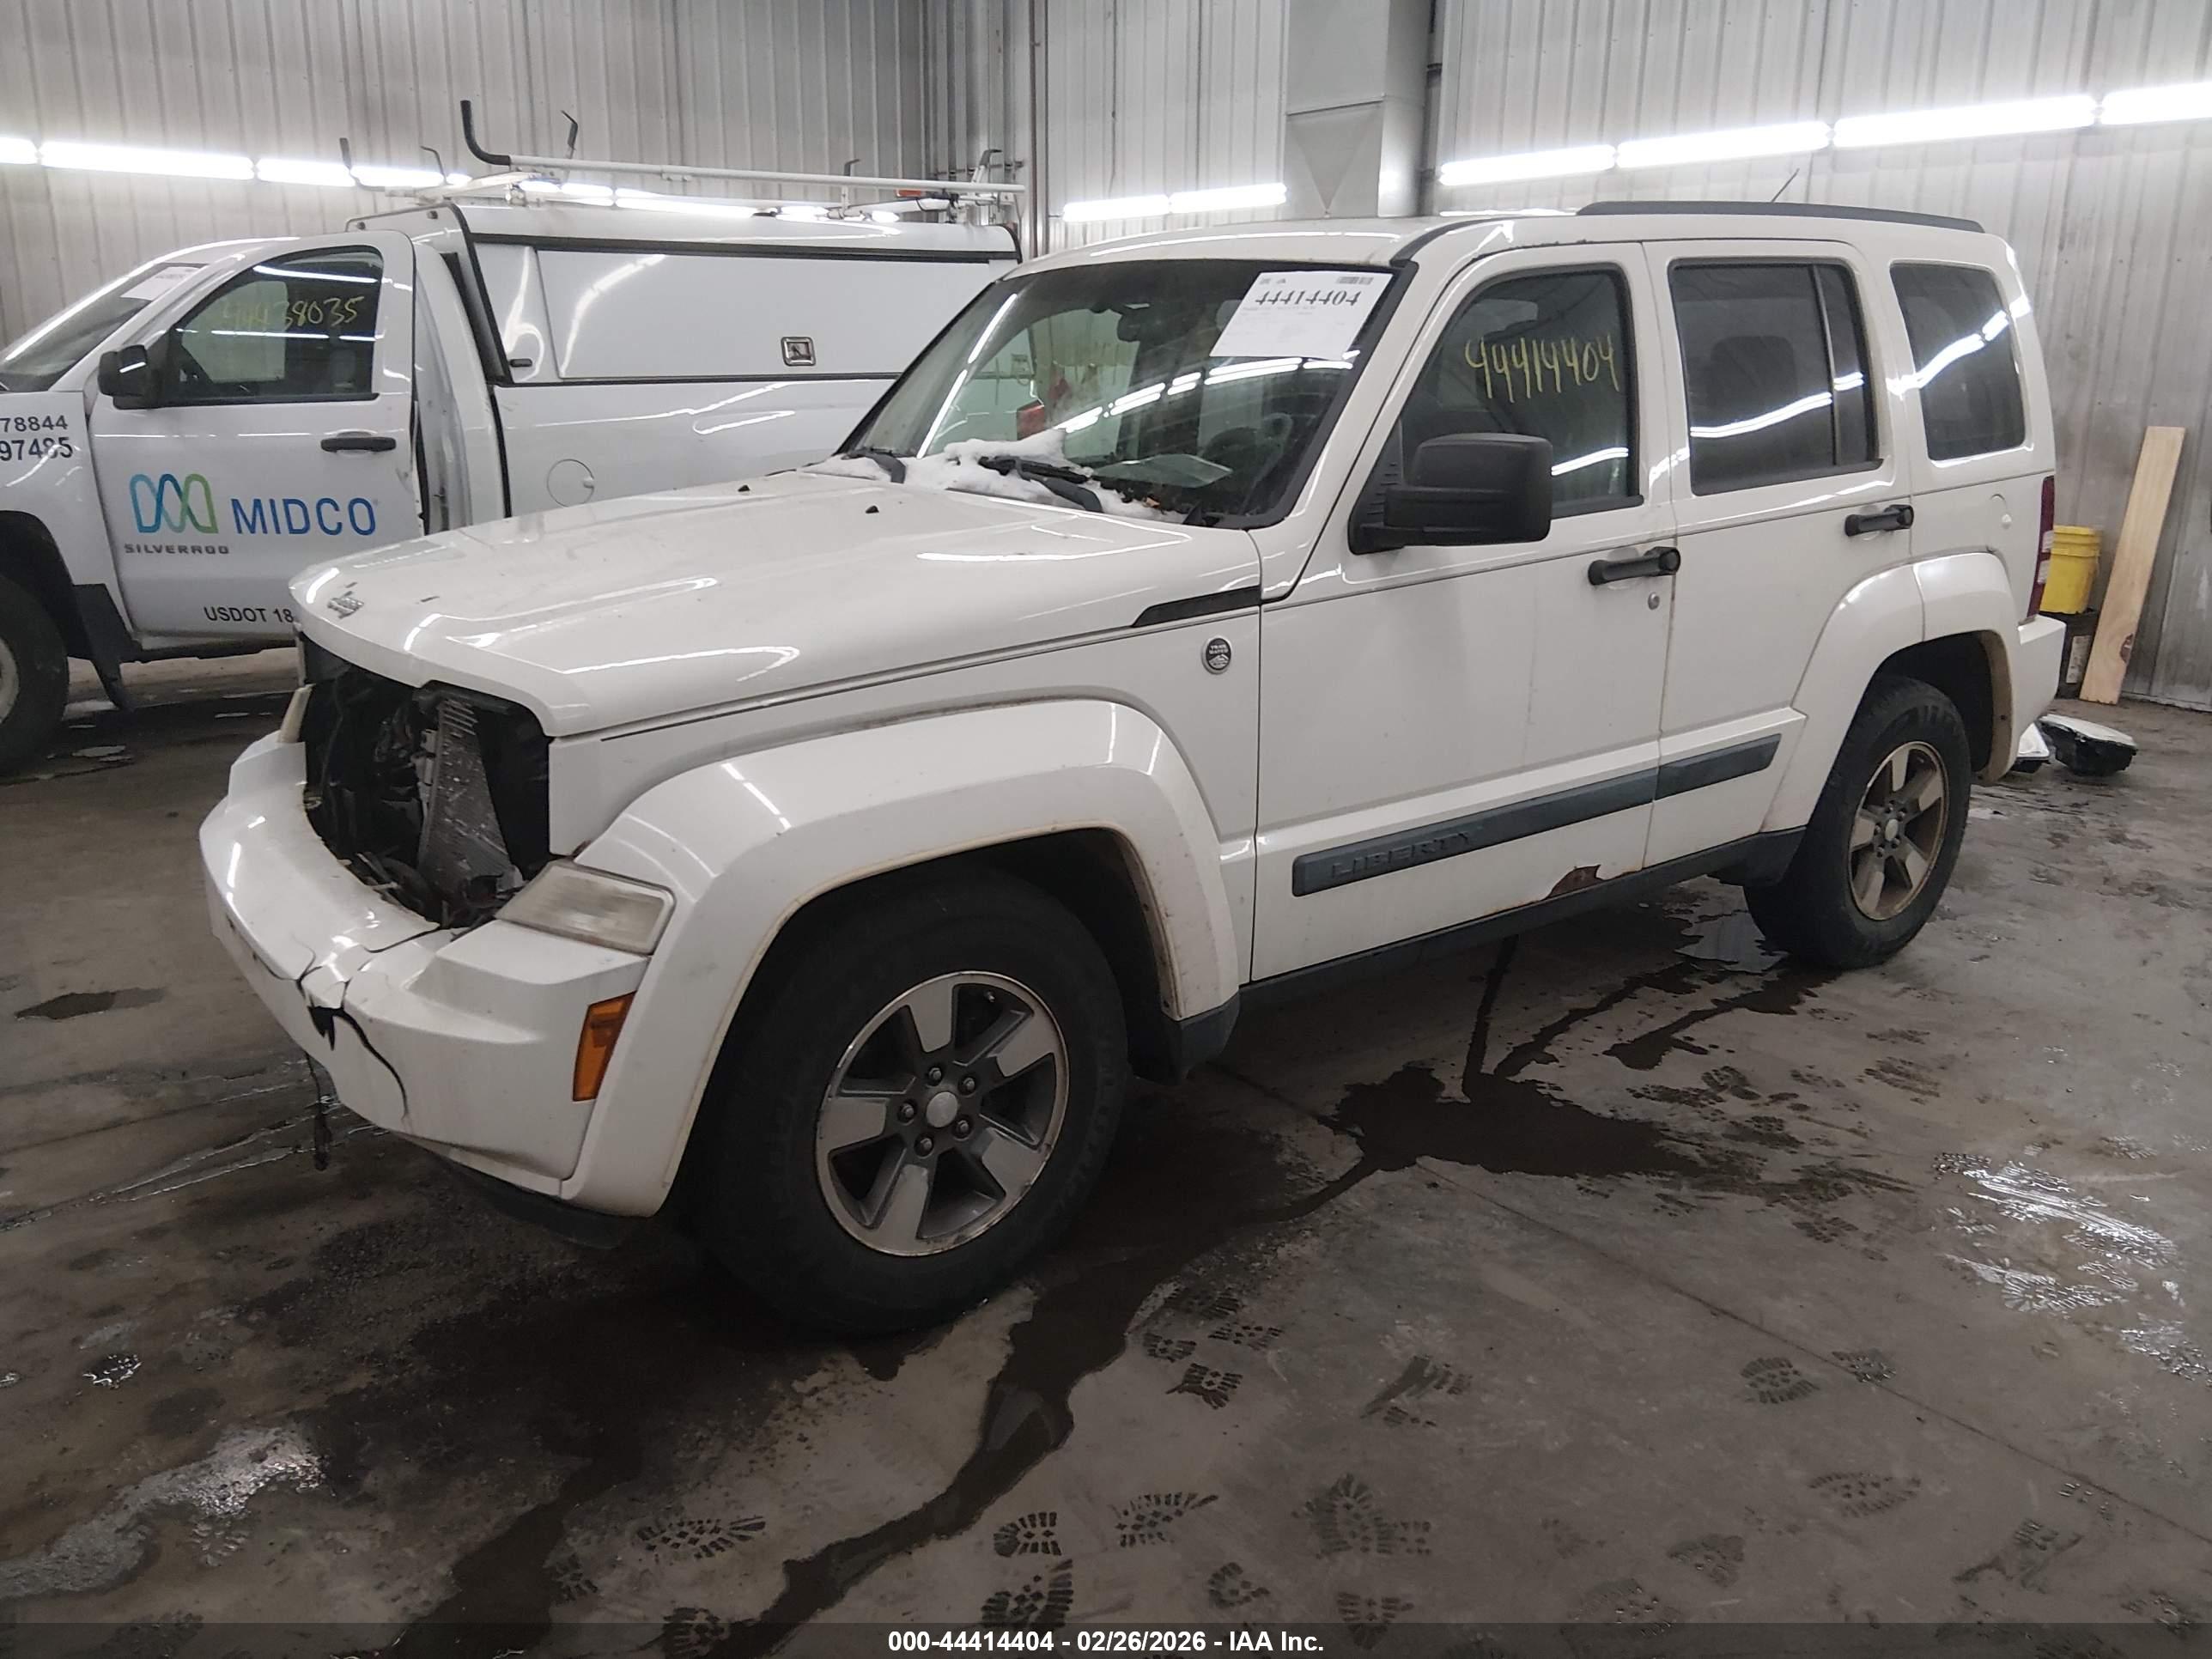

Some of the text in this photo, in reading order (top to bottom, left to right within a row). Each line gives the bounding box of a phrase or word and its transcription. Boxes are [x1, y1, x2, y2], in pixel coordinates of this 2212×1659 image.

[1254, 289, 1363, 307] 44414404
[1464, 331, 1620, 404] 44414404
[0, 415, 68, 433] 78844
[230, 497, 377, 536] MIDCO
[124, 544, 229, 555] SILVERADO
[204, 606, 295, 623] USDOT 18
[1332, 831, 1470, 878] LIBERTY
